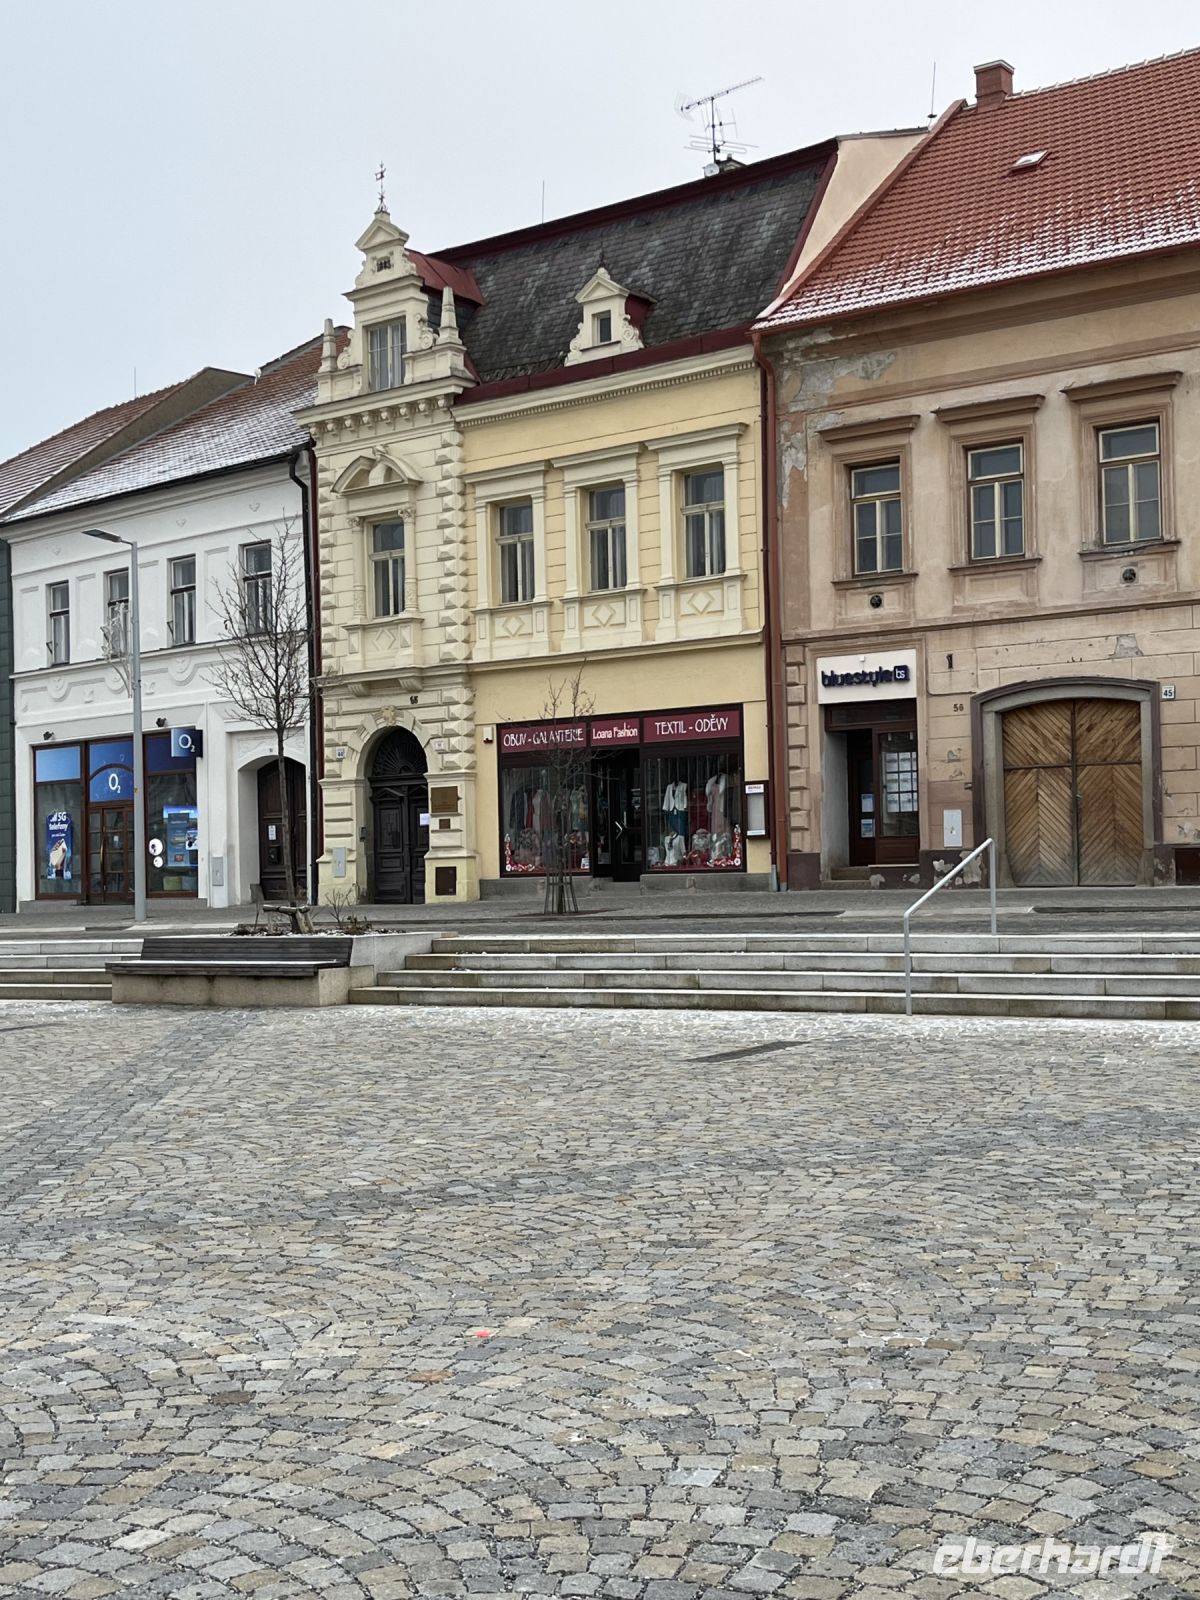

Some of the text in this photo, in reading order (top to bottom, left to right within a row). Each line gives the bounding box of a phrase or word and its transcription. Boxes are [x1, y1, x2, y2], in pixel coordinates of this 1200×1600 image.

[821, 666, 893, 688] bluestyle
[1163, 689, 1173, 697] 45
[592, 722, 638, 740] Loana Fashion
[654, 720, 687, 735] TEXTIL
[694, 714, 728, 733] ODĚVY
[178, 733, 196, 753] O2
[108, 773, 121, 794] O2
[57, 811, 67, 822] 5G
